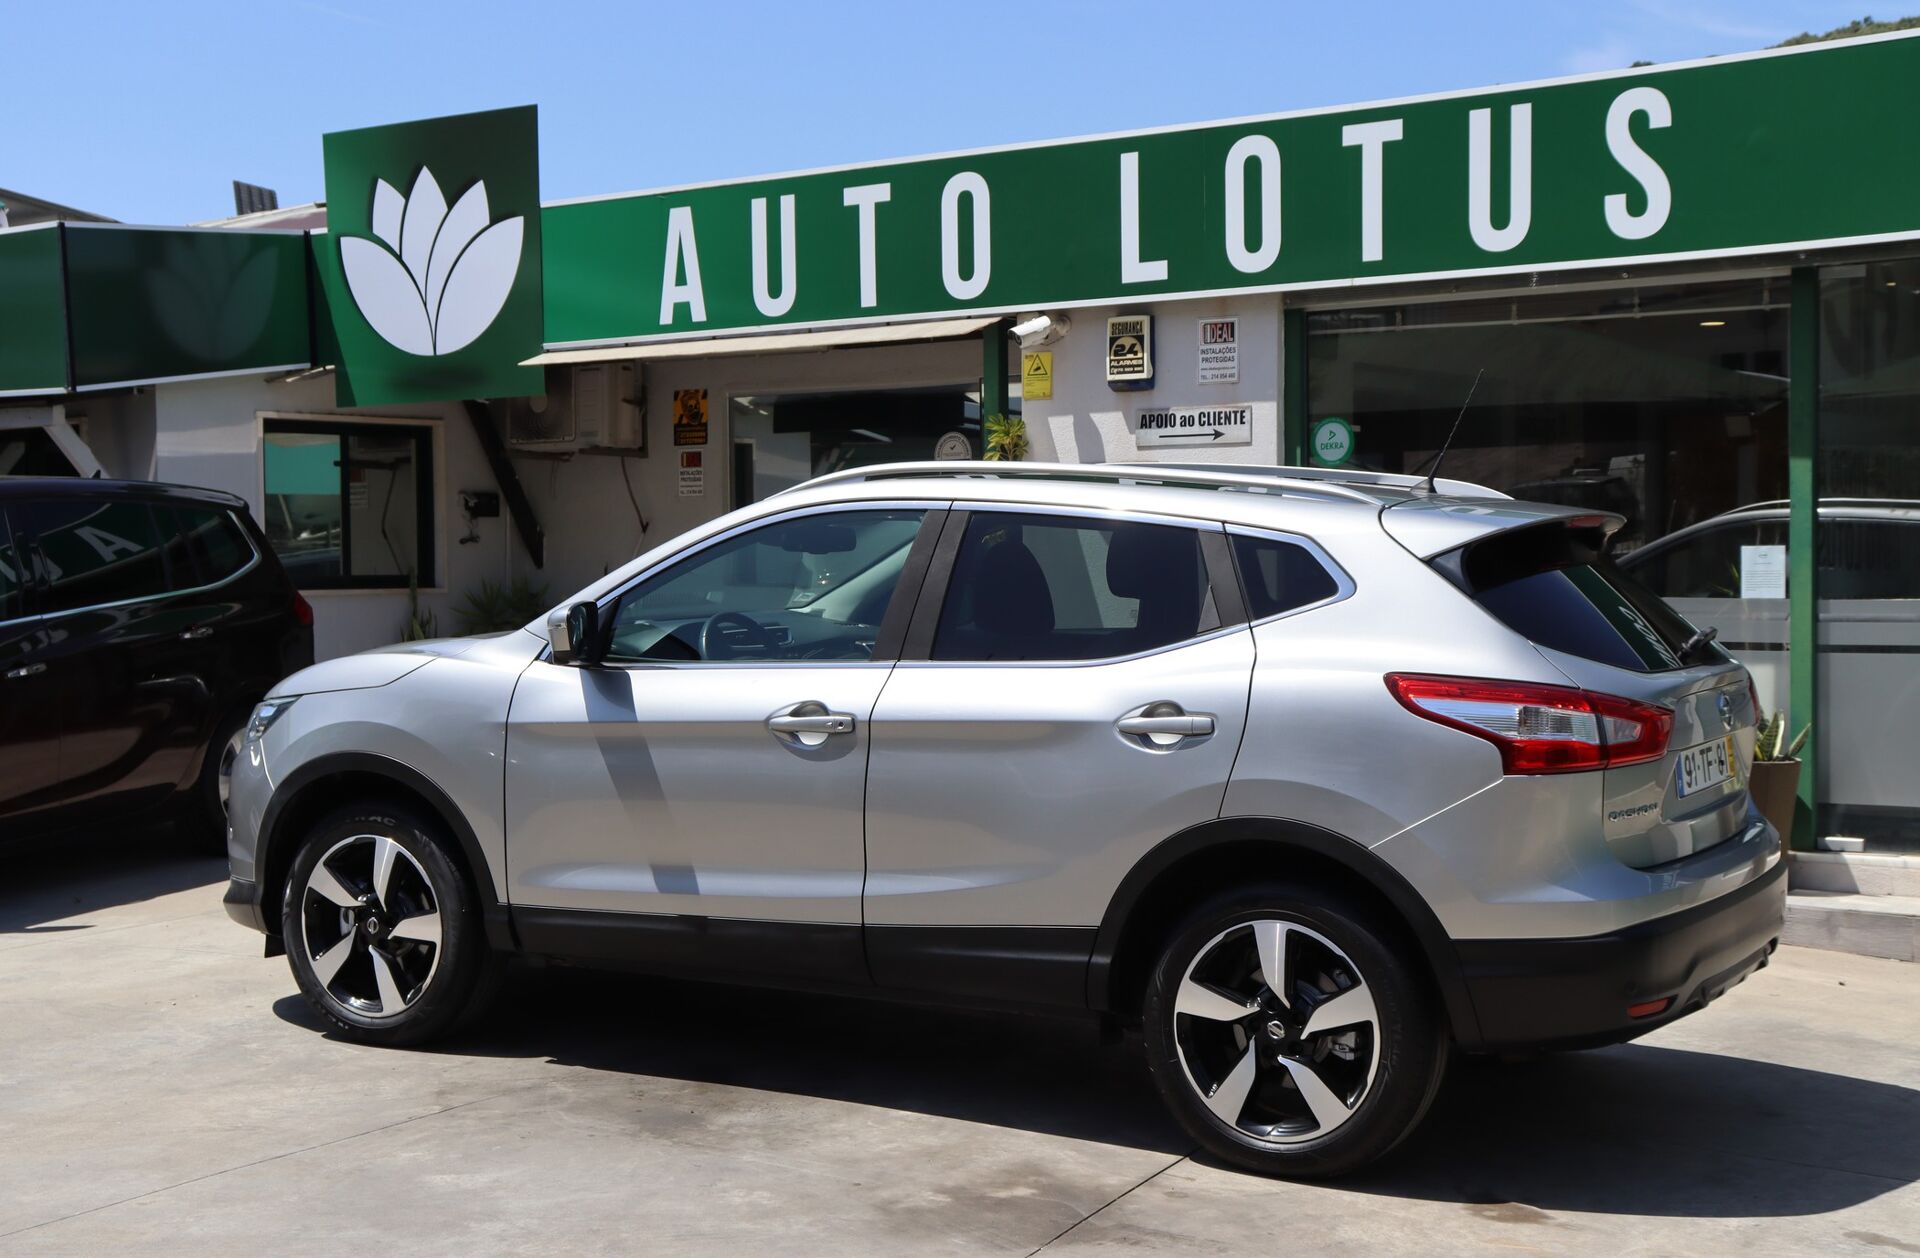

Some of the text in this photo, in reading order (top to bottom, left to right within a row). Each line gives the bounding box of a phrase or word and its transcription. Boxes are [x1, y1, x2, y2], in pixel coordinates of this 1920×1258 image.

[660, 87, 1672, 325] AUTO LOTUS
[1205, 323, 1234, 343] IDEAL
[1114, 343, 1139, 357] 24
[1200, 346, 1237, 355] INSTALAÇÕES
[1140, 410, 1246, 429] APOIO ao CLIENTE
[1320, 441, 1344, 450] DEKRA
